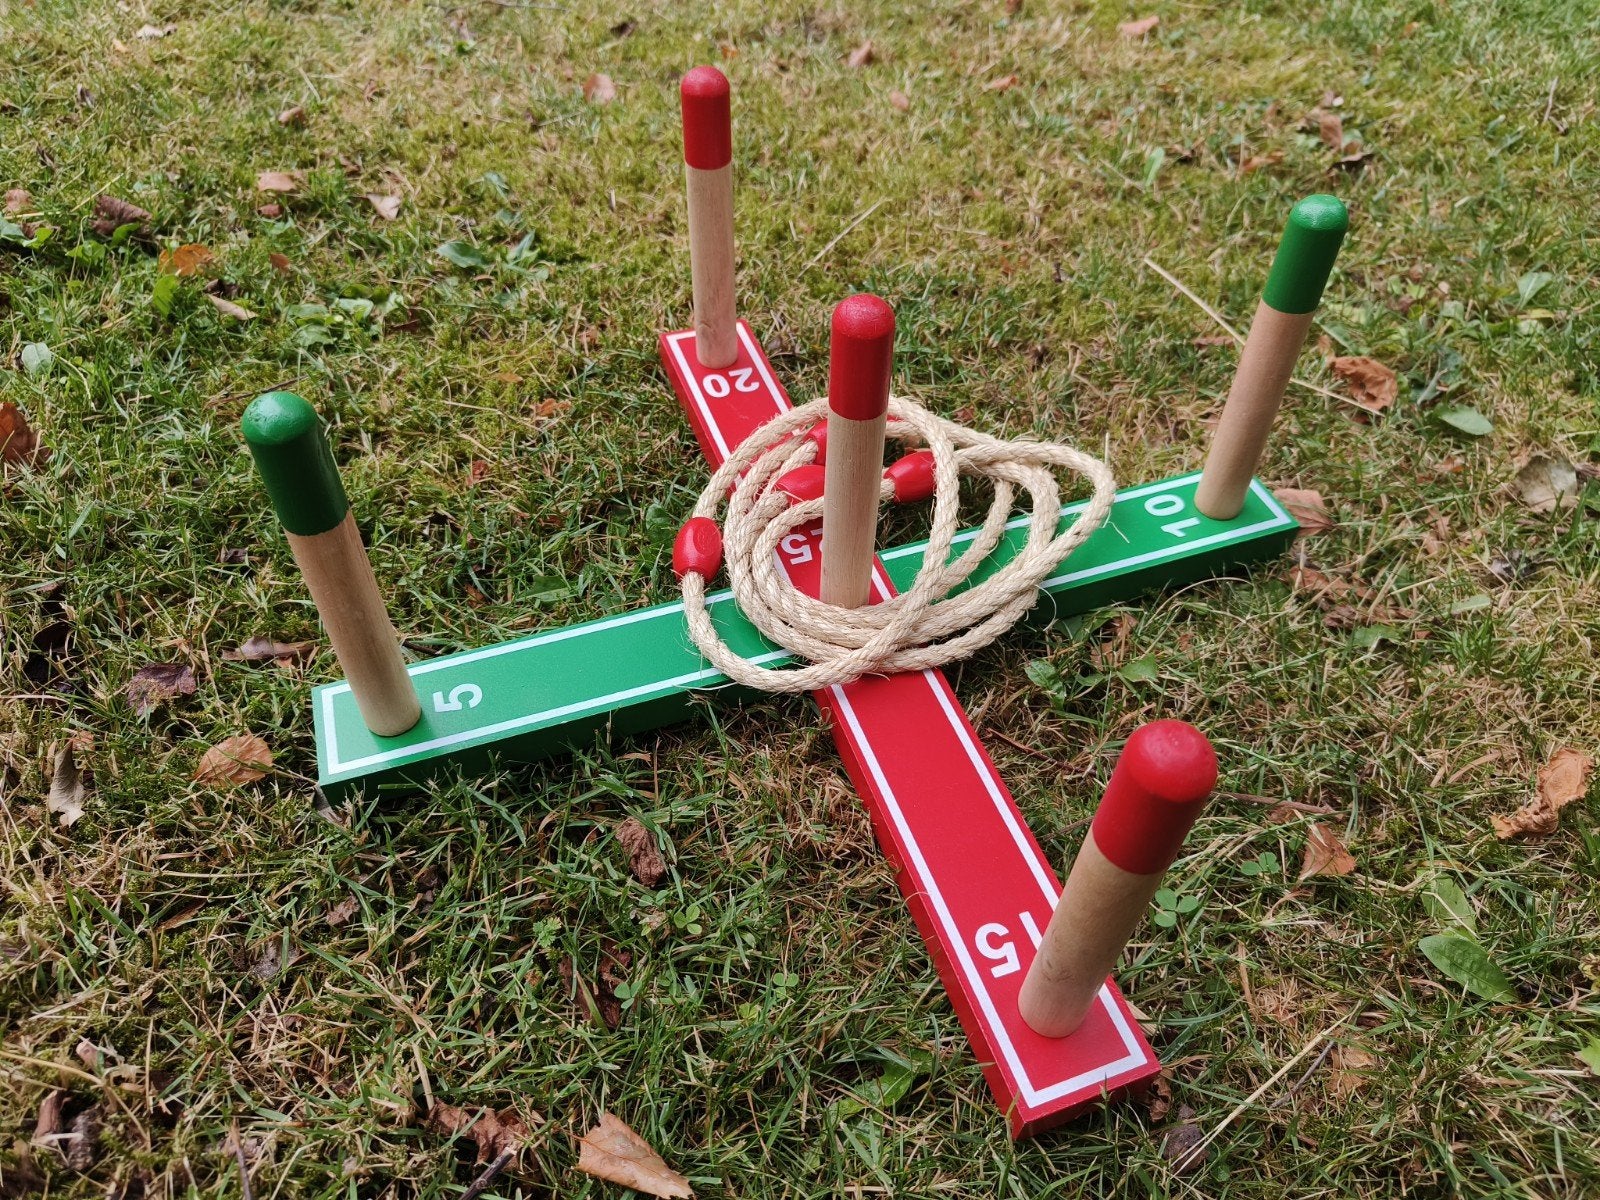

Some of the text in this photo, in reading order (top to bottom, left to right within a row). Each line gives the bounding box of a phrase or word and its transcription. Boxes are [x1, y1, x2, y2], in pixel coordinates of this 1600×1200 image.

[702, 367, 760, 398] 20
[1144, 494, 1200, 537] 10
[781, 528, 823, 565] 5
[433, 683, 483, 712] 5
